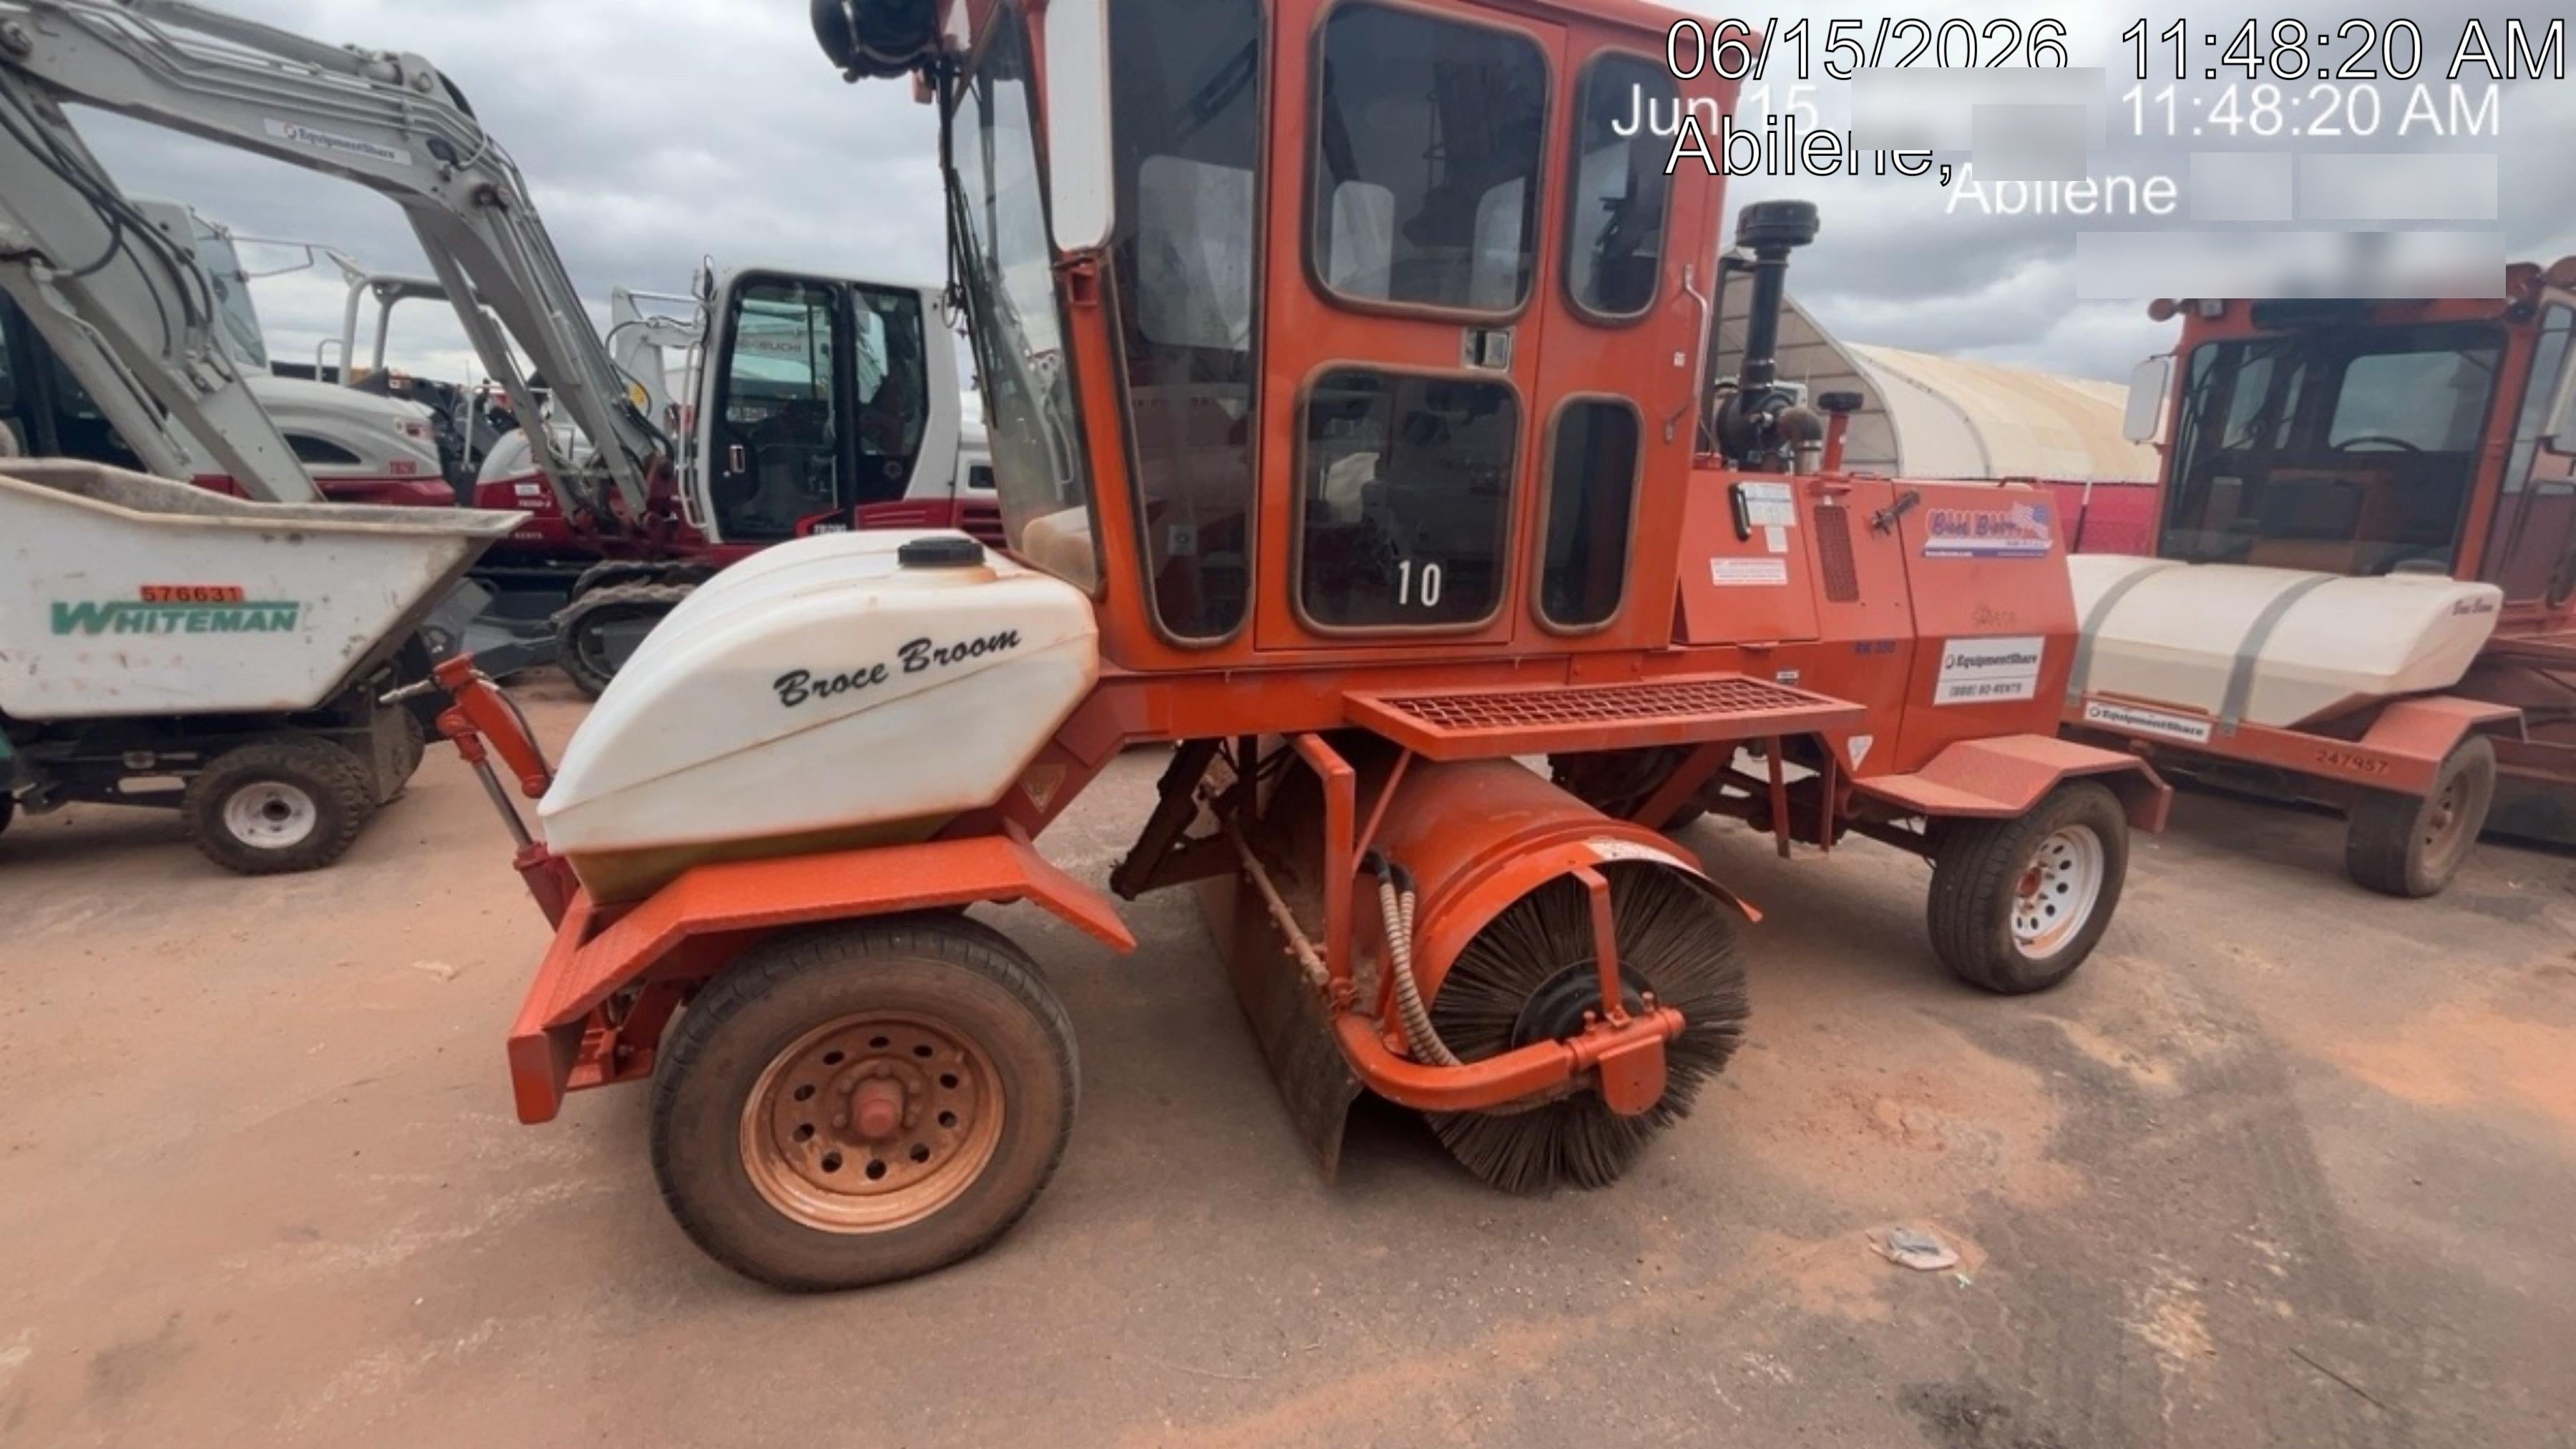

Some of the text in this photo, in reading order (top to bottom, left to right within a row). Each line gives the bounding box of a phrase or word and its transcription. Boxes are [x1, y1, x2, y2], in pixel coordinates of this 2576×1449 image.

[1399, 560, 1441, 607] 10
[50, 600, 300, 635] WHITEMAN
[773, 629, 1021, 707] Broce Broom
[1956, 653, 2038, 668] EquipmentShare
[2102, 710, 2205, 736] EquipmentShare
[2316, 749, 2389, 774] 247957
